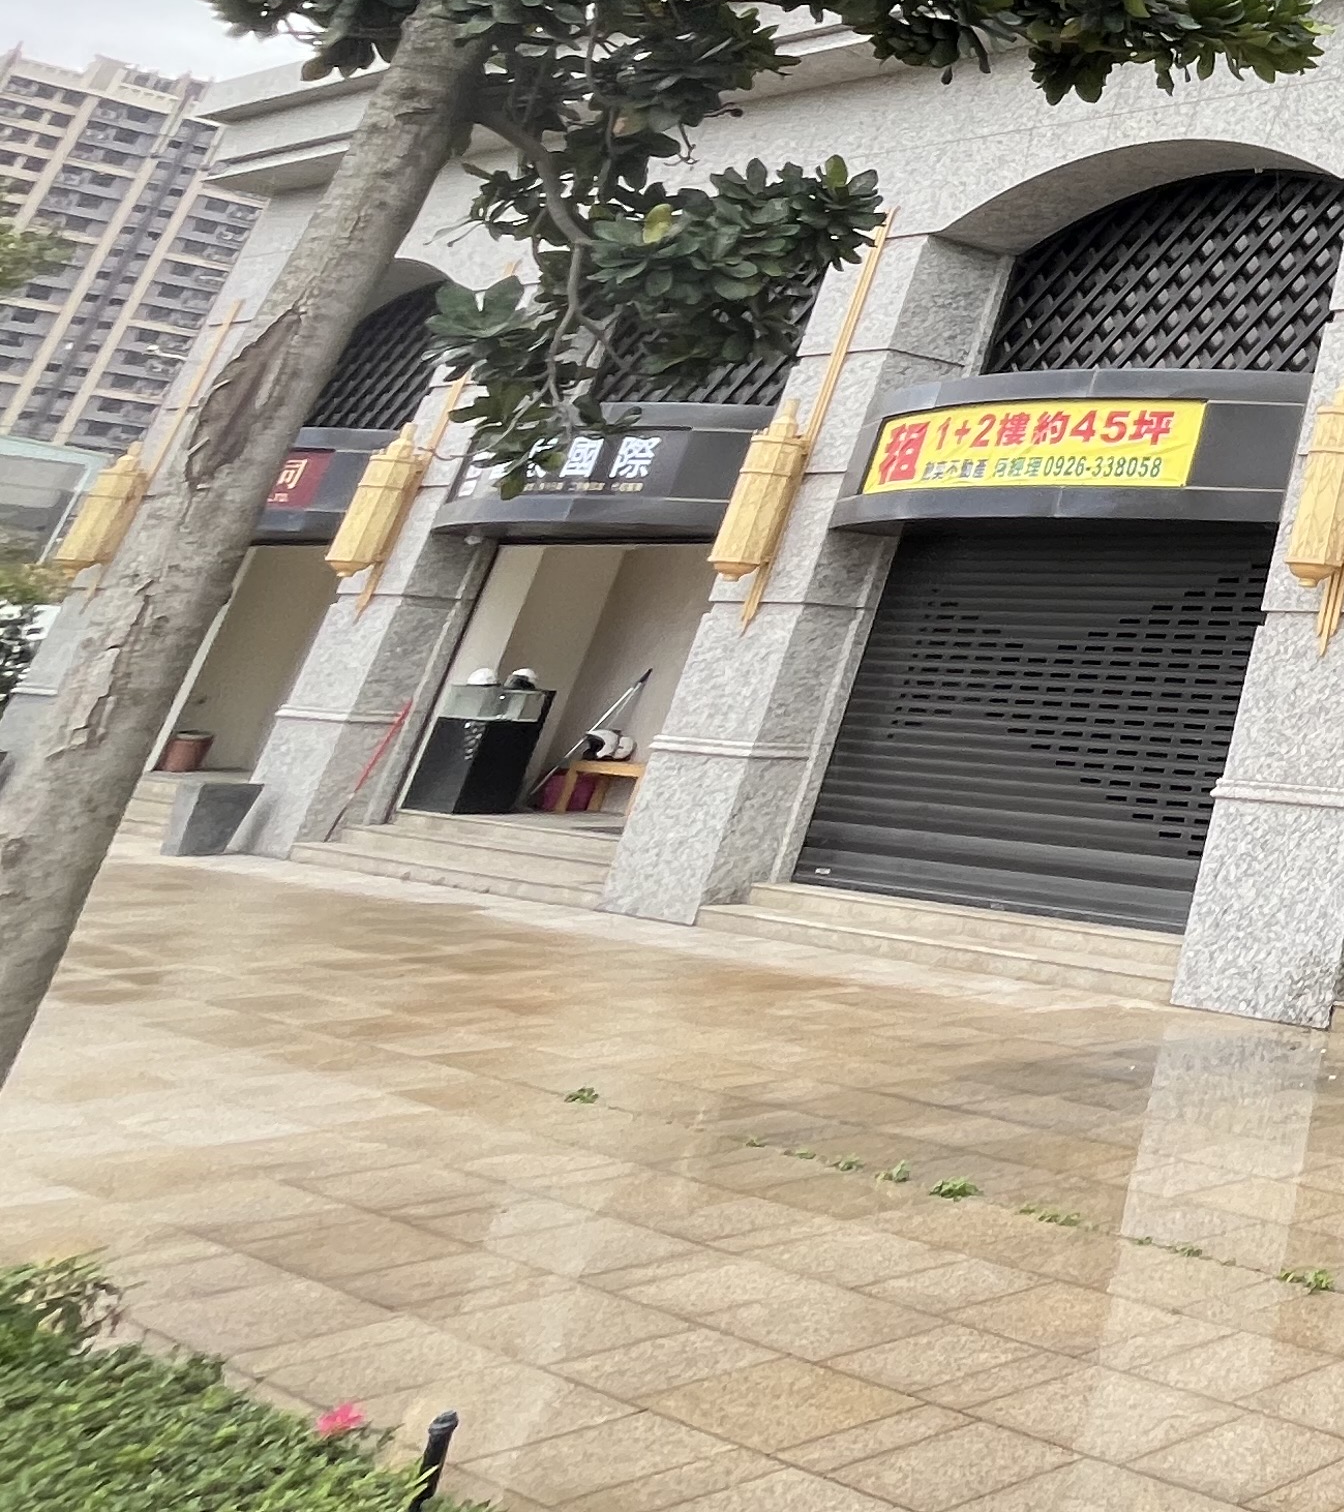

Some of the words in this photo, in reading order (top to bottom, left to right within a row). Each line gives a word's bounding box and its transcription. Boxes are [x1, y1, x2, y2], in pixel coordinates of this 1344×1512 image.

[878, 421, 931, 485] 租
[935, 409, 1175, 450] 1+2樓約45坪
